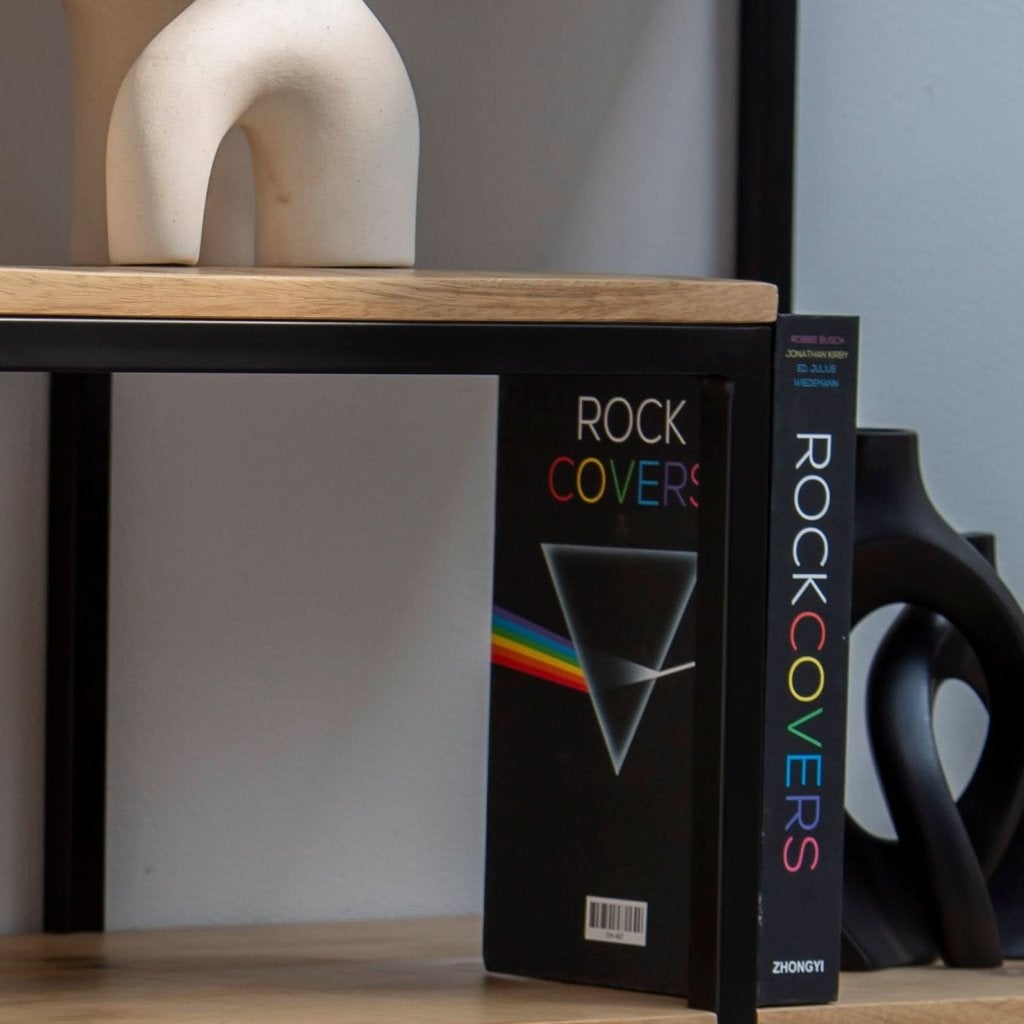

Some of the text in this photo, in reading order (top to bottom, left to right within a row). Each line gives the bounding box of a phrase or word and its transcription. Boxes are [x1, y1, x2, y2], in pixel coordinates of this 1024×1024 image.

[784, 349, 827, 359] JONATHAN
[578, 396, 687, 445] ROCK
[783, 433, 832, 873] ROCK COVERS
[772, 959, 825, 974] ZHONGYI
